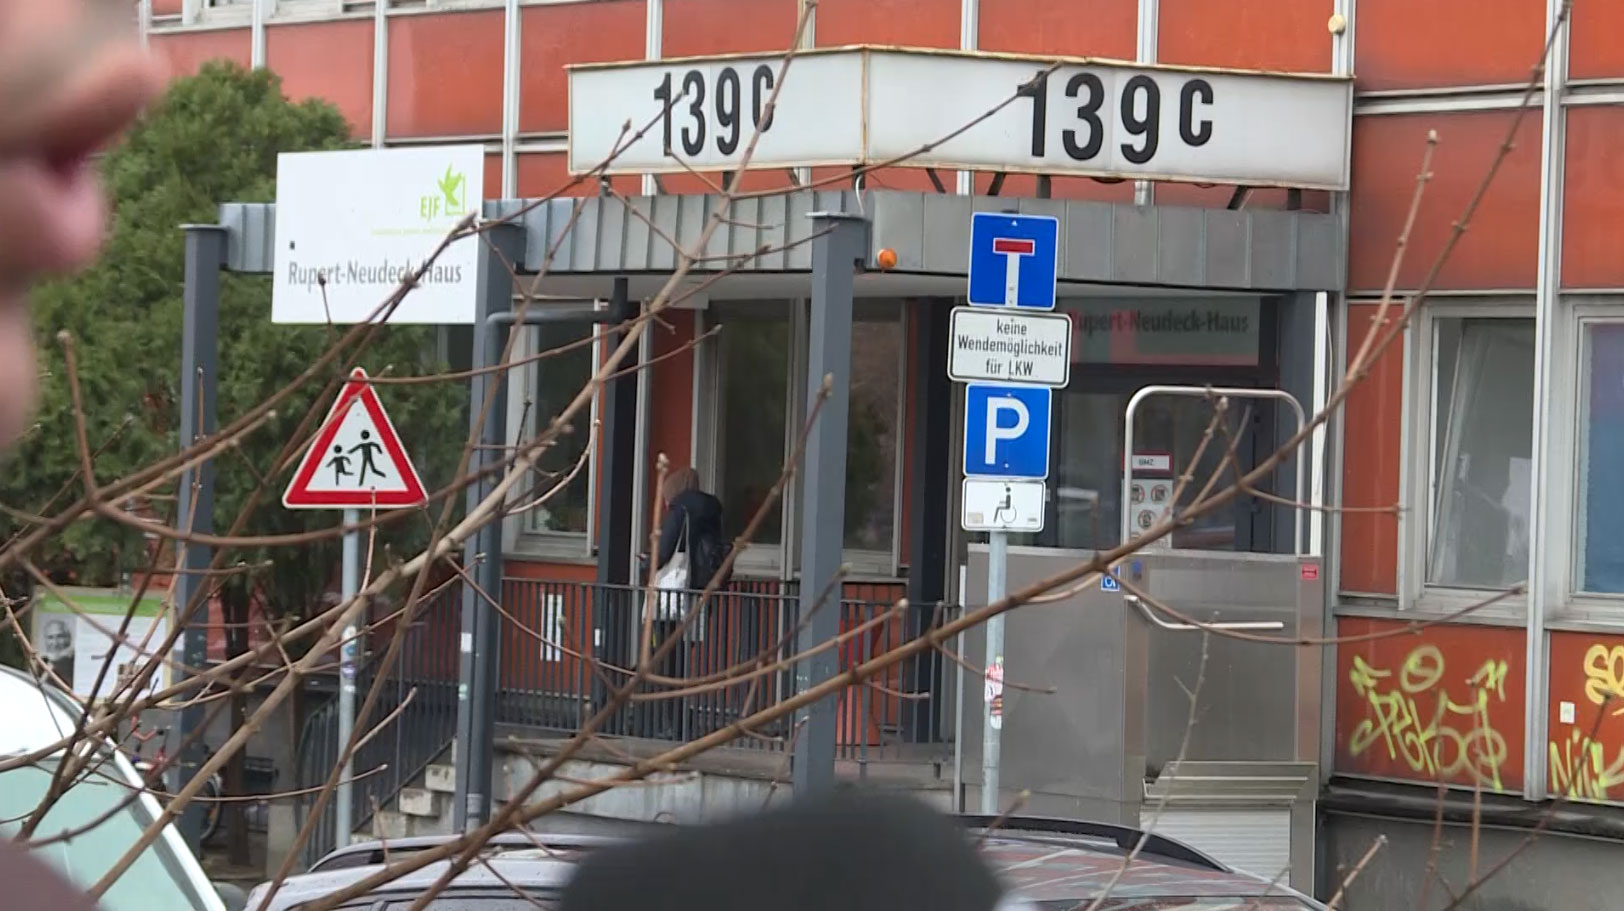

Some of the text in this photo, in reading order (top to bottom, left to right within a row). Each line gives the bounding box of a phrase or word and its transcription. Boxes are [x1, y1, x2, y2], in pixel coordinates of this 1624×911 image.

[420, 196, 441, 222] EJF
[996, 318, 1027, 335] keine
[958, 335, 1063, 357] Wendemöglichkeit
[985, 357, 1033, 377] für LKW
[984, 396, 1030, 466] P
